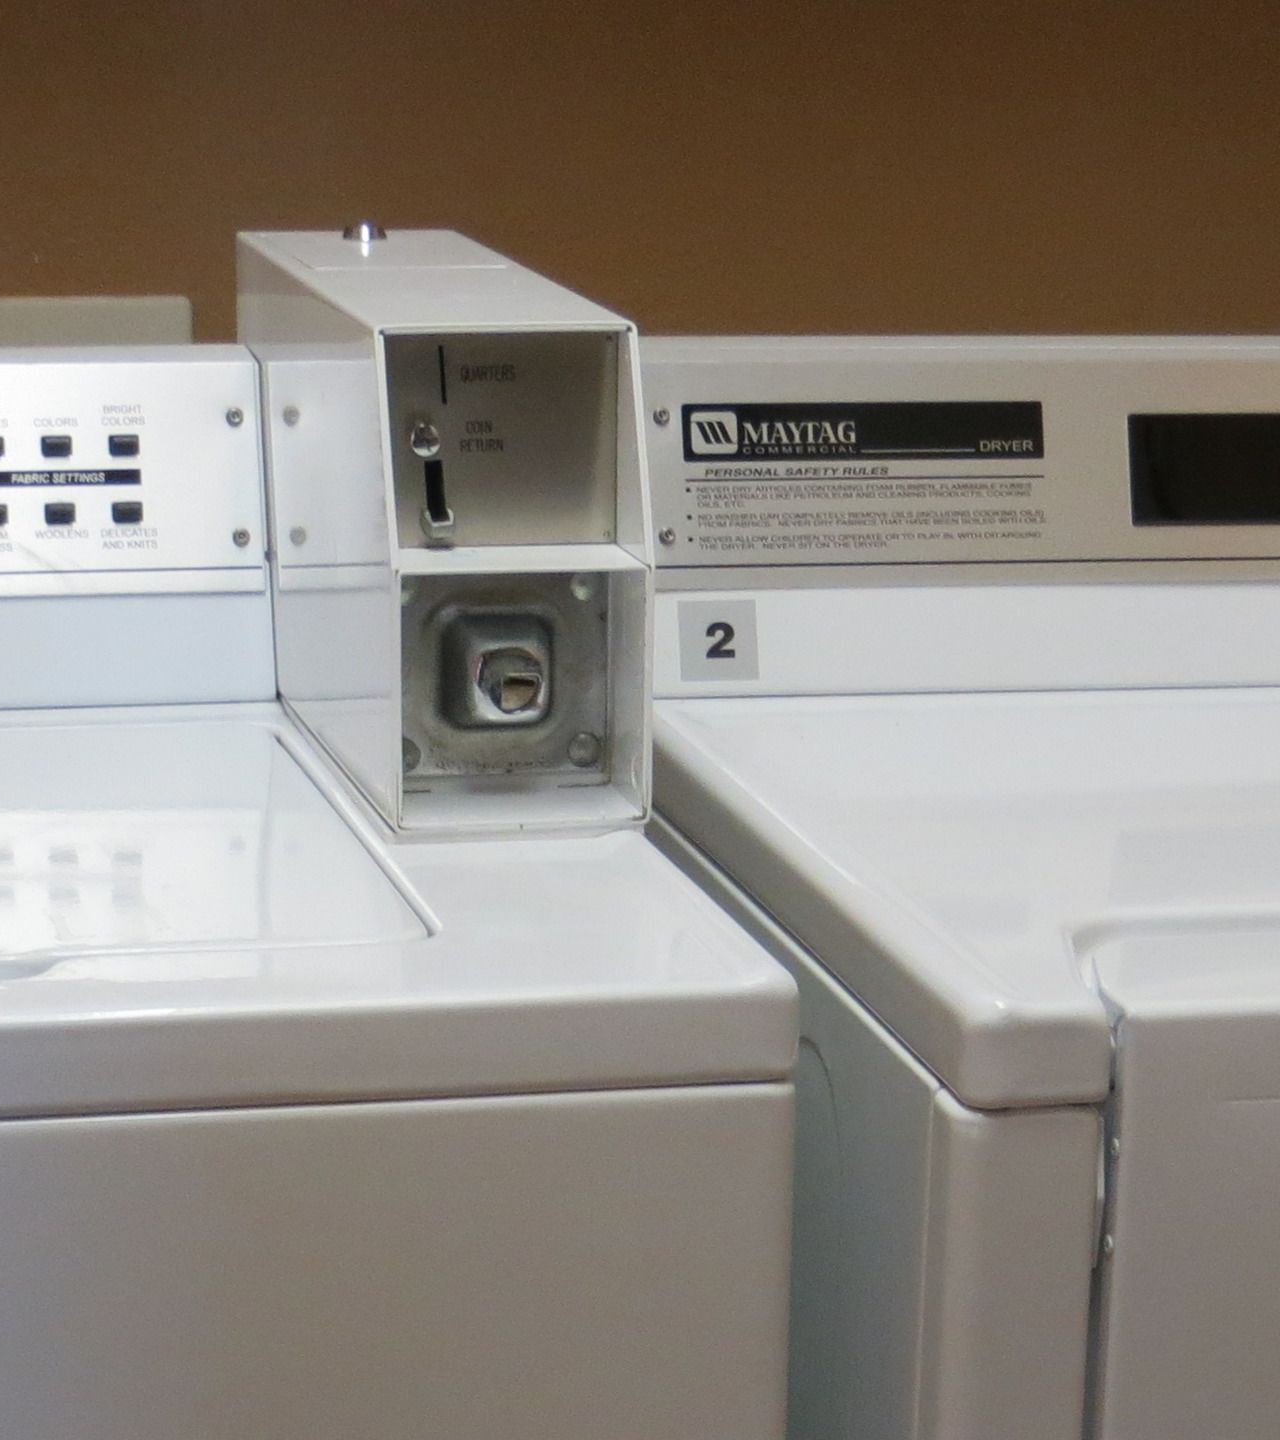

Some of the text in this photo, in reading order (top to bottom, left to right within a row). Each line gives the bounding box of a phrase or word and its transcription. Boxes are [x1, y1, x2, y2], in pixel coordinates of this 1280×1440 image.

[460, 364, 516, 382] QUARTERS
[102, 404, 142, 414] BRIGHT
[34, 417, 78, 427] COLORS
[101, 416, 145, 426] COLORS
[465, 420, 493, 433] COIN
[742, 420, 856, 444] MAYTAG
[459, 438, 503, 452] RETURN
[742, 444, 857, 454] COMMERCIAL
[979, 439, 1034, 452] DRYER
[705, 466, 889, 477] PERSONAL SAFETY RULES
[11, 472, 106, 484] FABRIC SETTINGS
[35, 530, 88, 539] WOOLENS
[101, 528, 158, 538] DELICATES
[102, 540, 158, 549] AND KNITS
[705, 621, 736, 659] 2
